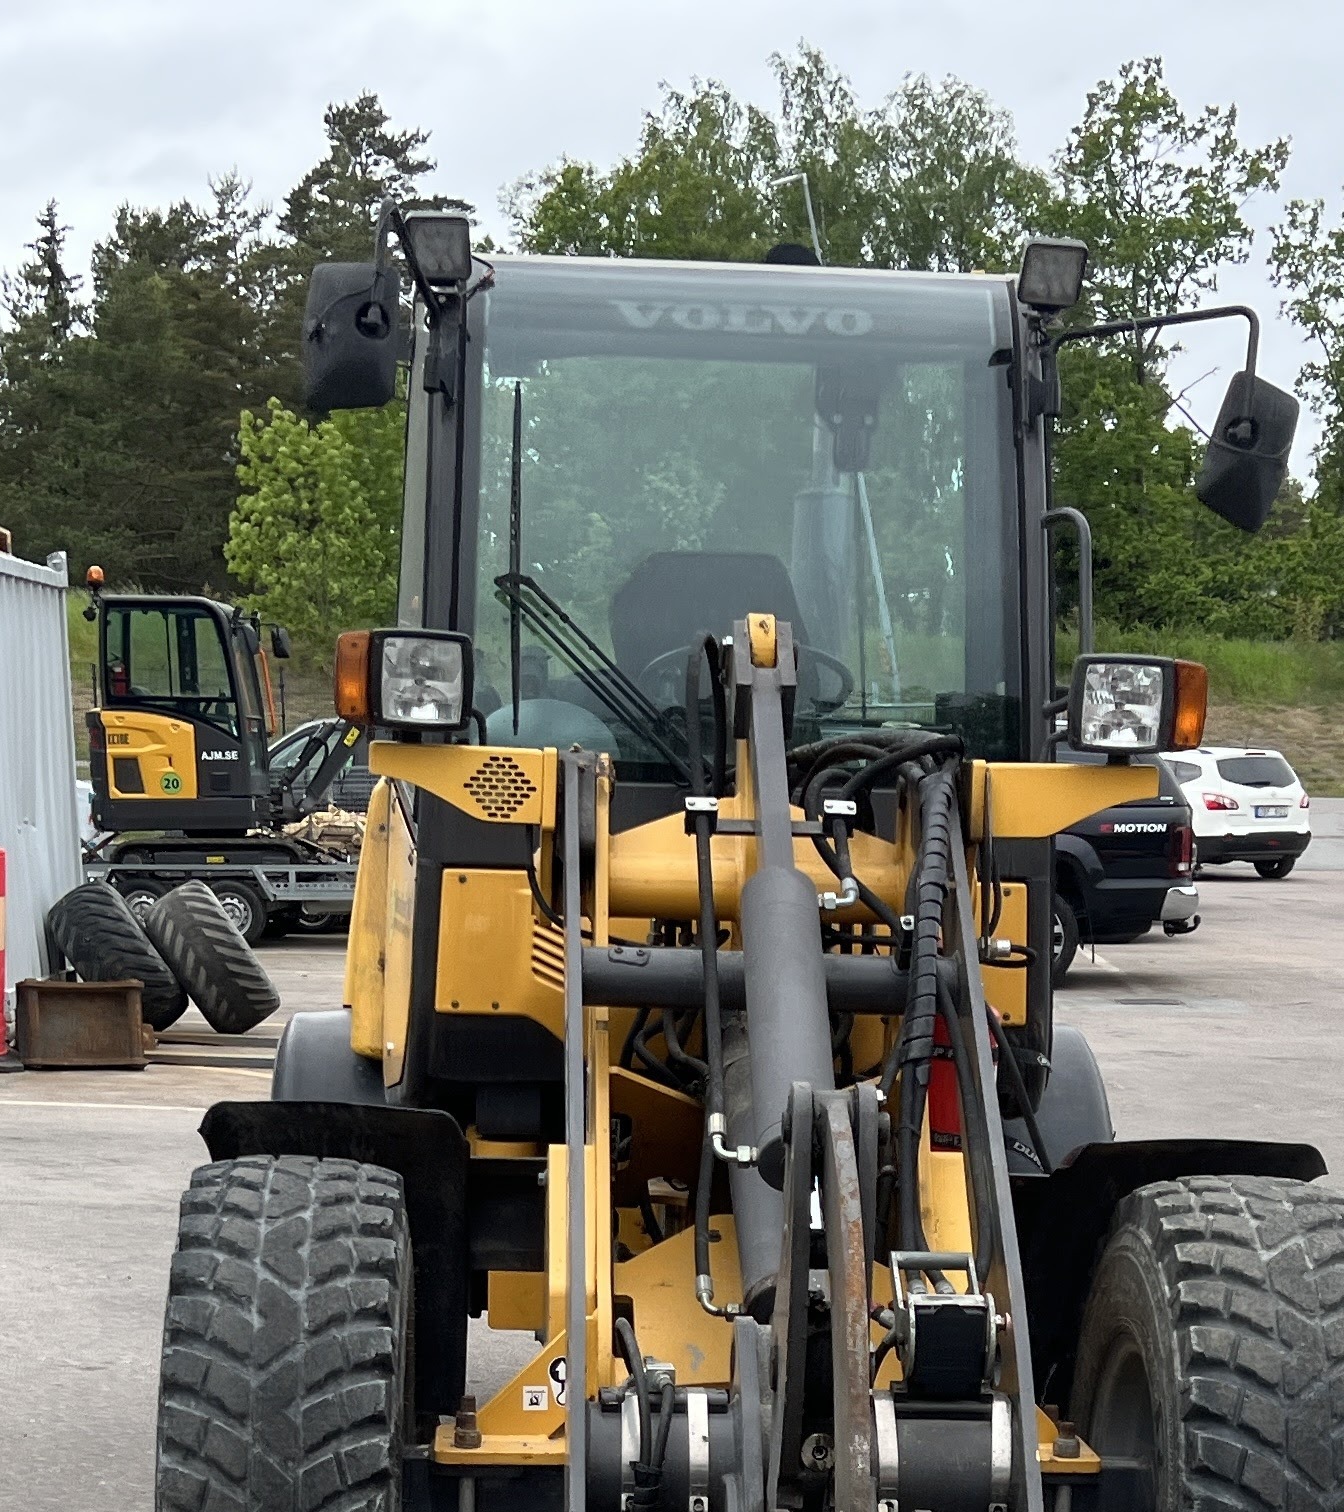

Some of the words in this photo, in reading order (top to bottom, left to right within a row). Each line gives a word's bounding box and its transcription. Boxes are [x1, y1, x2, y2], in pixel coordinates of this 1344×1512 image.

[609, 300, 874, 336] VOLVO
[201, 750, 239, 761] AJM.SE
[163, 777, 181, 790] 20
